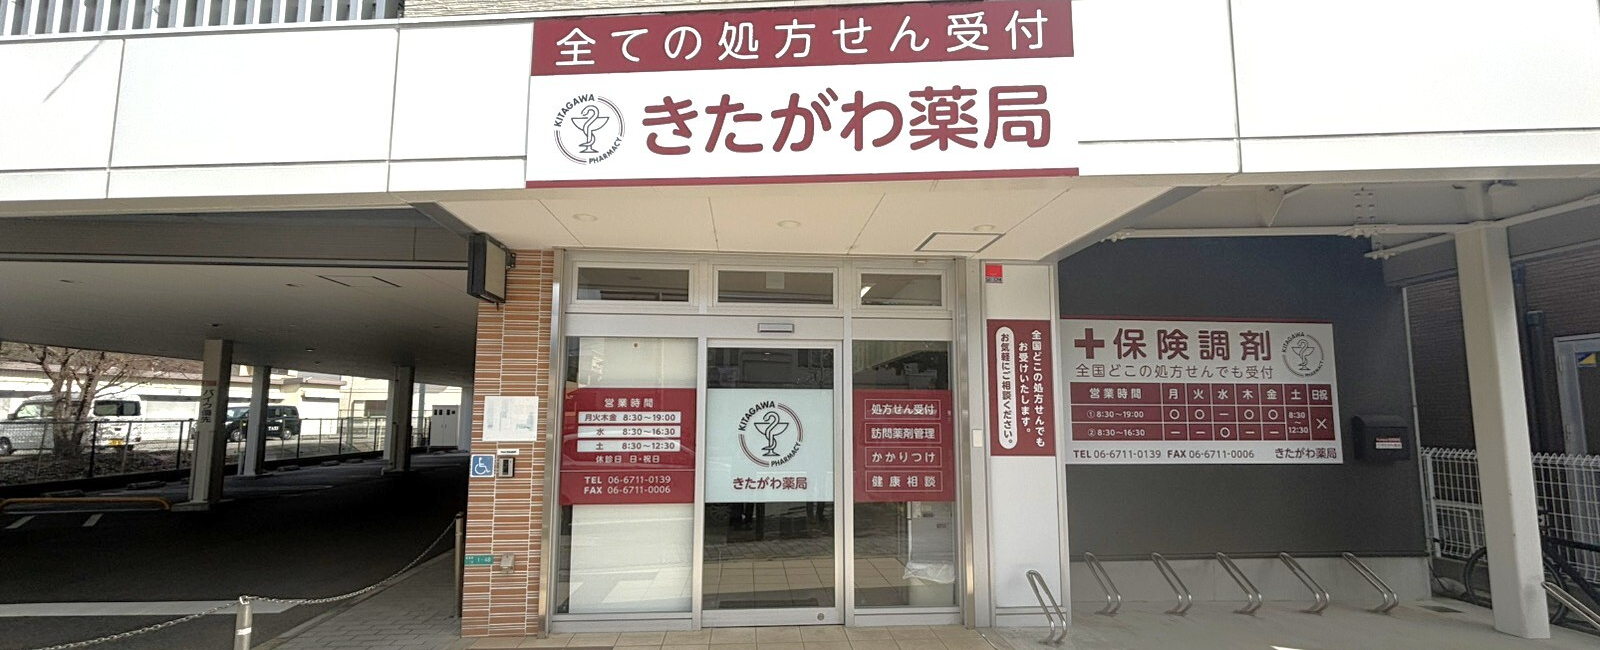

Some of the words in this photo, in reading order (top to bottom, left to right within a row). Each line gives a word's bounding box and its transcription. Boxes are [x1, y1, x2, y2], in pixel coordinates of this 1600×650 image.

[555, 10, 1049, 66] 全ての処方せん受付
[553, 93, 595, 127] KITAGAWA
[641, 84, 1052, 156] きたがわ薬局
[588, 136, 622, 164] PHARMACY
[1112, 327, 1272, 361] 保険調剤
[1075, 363, 1274, 379] 全国どこの処方せんでも受付
[1000, 332, 1013, 444] お気軽にご相談ください。
[1018, 341, 1031, 433] お受けいたします。
[1031, 329, 1045, 447] 全国どこの処方せんでも
[1089, 387, 1142, 399] 営業時間
[1168, 389, 1179, 399] 月
[1193, 389, 1204, 399] 火
[1217, 389, 1229, 400] 水
[1242, 389, 1253, 400] 木
[1266, 389, 1278, 400] 金
[1290, 389, 1302, 400] 土
[1311, 389, 1329, 400] 日祝
[604, 398, 654, 409] 営業時間
[871, 403, 936, 416] 処方せん受付
[584, 413, 617, 422] 月火木金
[737, 400, 776, 432] KITAGAWA
[1288, 411, 1306, 419] 8:30
[596, 427, 605, 436] 水
[871, 427, 936, 439] 訪問薬剤管理
[1288, 426, 1309, 434] 12:30
[595, 442, 604, 451] 土
[1274, 447, 1337, 459] きたがわ薬局
[595, 455, 622, 464] 休診日
[770, 442, 802, 468] PHARMACY
[871, 452, 936, 463] かかりつけ
[1073, 450, 1091, 459] TEL
[1093, 450, 1161, 459] 06-6711-0139
[1167, 450, 1186, 459] FAX
[1189, 450, 1255, 459] 06-6711-0006
[584, 476, 602, 485] TEL
[607, 475, 672, 484] 06-6711-0139
[732, 476, 808, 490] きたがわ薬局
[871, 475, 937, 488] 健康相談
[583, 486, 603, 495] FAX
[607, 486, 672, 494] 06-6711-0006
